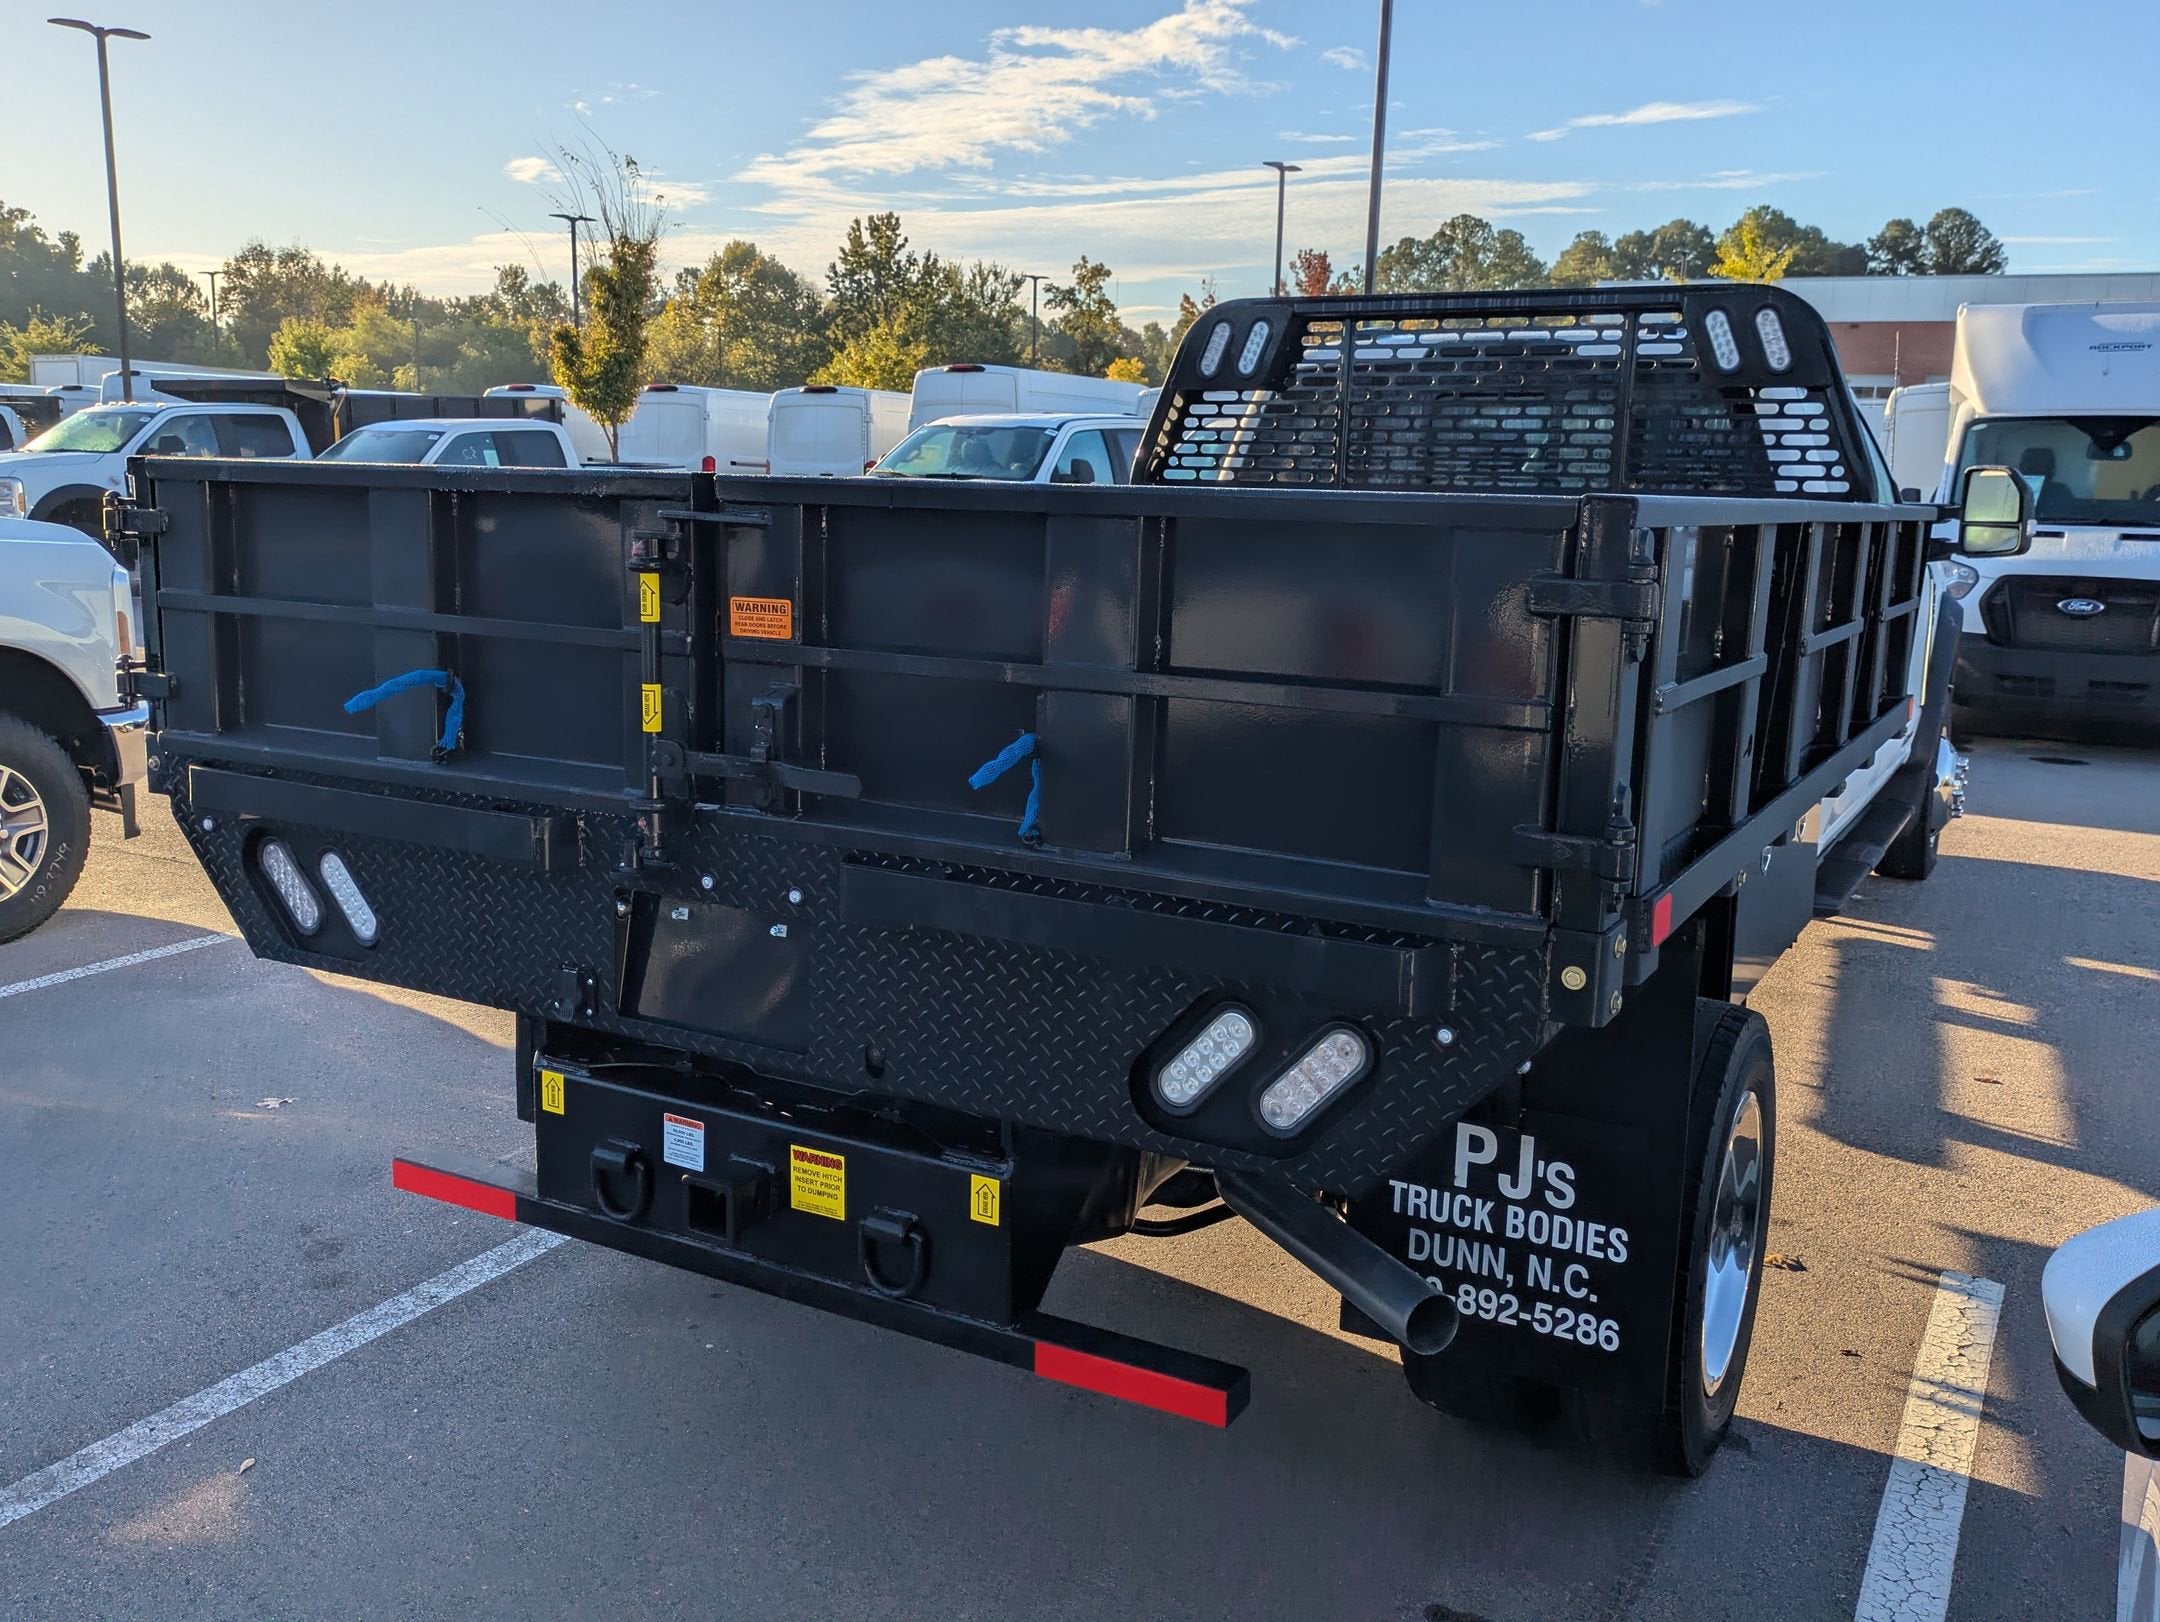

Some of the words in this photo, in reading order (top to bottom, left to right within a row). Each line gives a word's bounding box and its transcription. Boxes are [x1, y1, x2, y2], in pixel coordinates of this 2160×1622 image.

[734, 602, 787, 614] WARNING
[792, 1149, 843, 1171] WARNING
[1454, 1122, 1575, 1209] PJ'S
[793, 1165, 820, 1178] REMOVE
[822, 1173, 842, 1183] HITCH
[795, 1175, 818, 1187] INSERT
[820, 1182, 840, 1191] PRIOR
[808, 1188, 838, 1200] DUMPING
[1389, 1180, 1494, 1233] TRUCK
[1506, 1205, 1628, 1263] BODIES
[1409, 1228, 1513, 1287] DUNN,
[1528, 1254, 1597, 1302] N.C.
[1424, 1276, 1619, 1351] -892-5286
